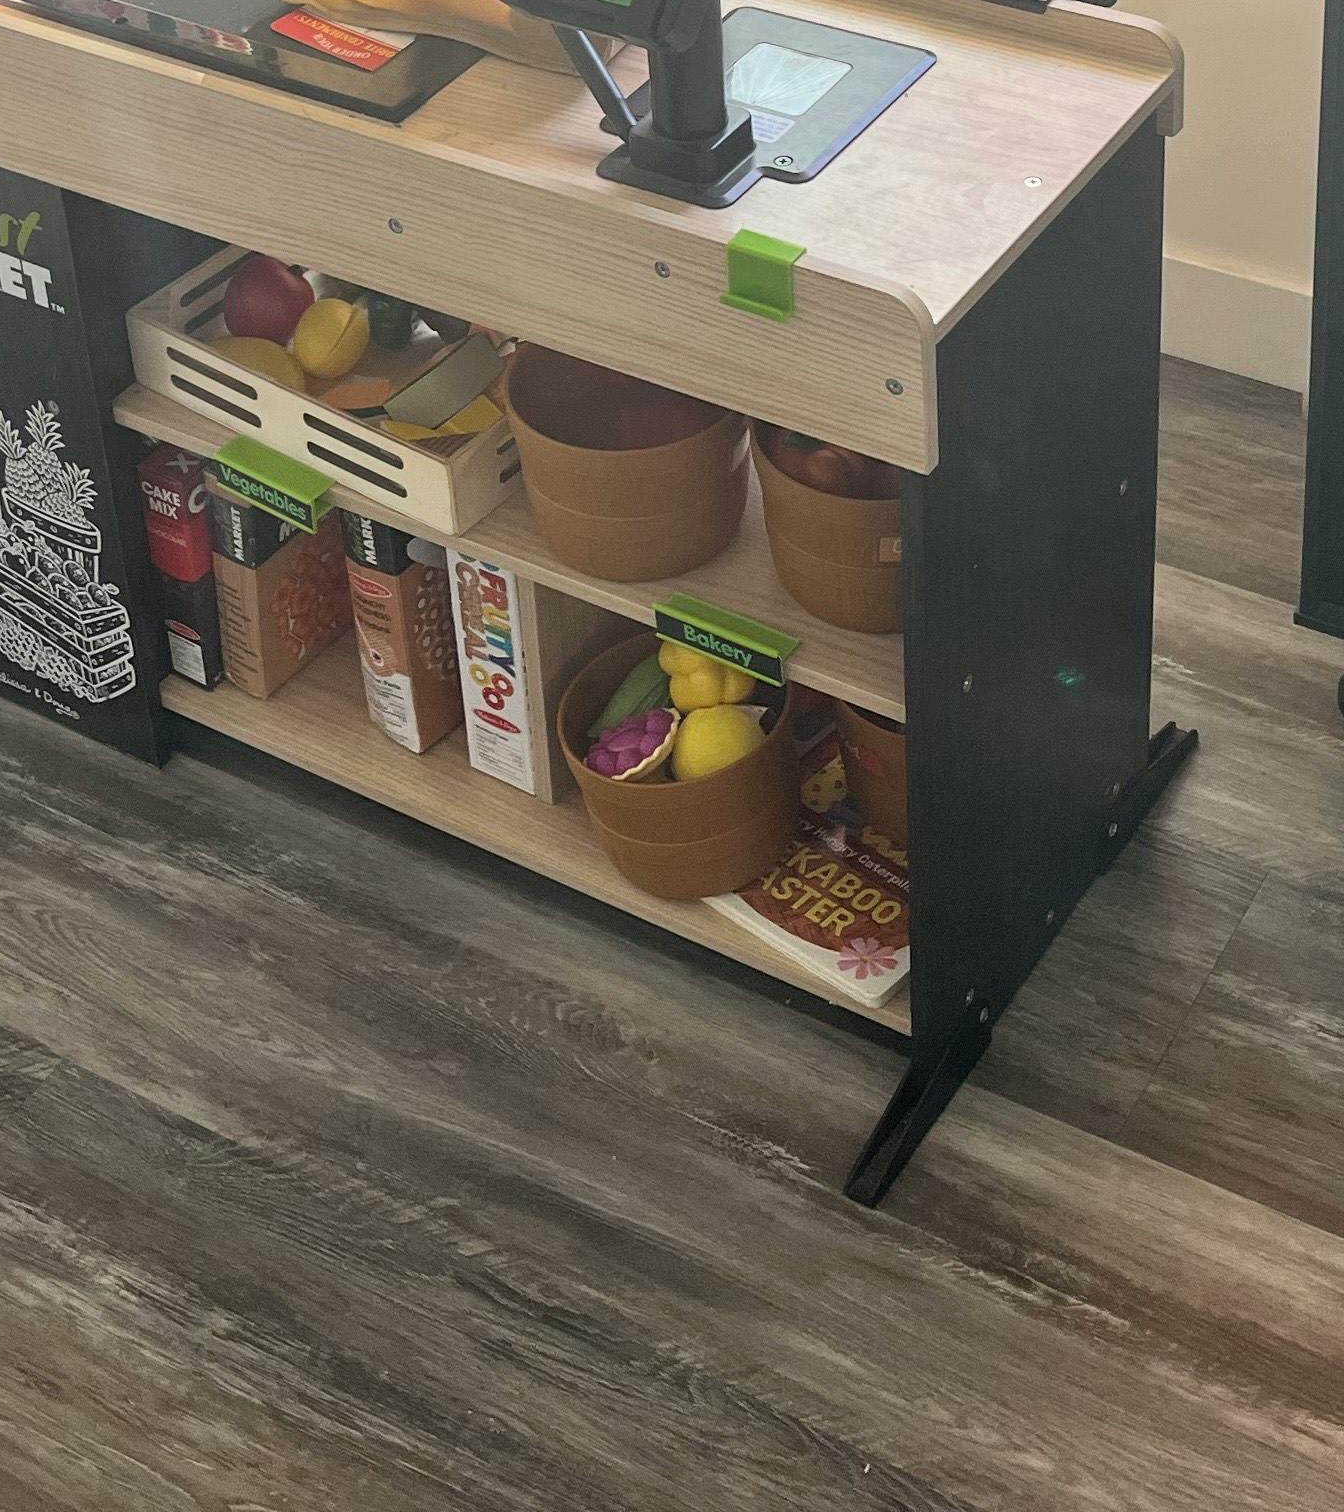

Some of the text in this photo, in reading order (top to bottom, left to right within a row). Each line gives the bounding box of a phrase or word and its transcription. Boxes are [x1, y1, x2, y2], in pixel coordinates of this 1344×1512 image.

[141, 481, 182, 508] CAKE
[149, 495, 179, 520] MIX
[220, 462, 307, 522] Vegetables
[229, 505, 246, 563] MARKET
[455, 559, 491, 664] CEREAL
[478, 566, 518, 680] FRUITY
[682, 622, 754, 668] Bakery
